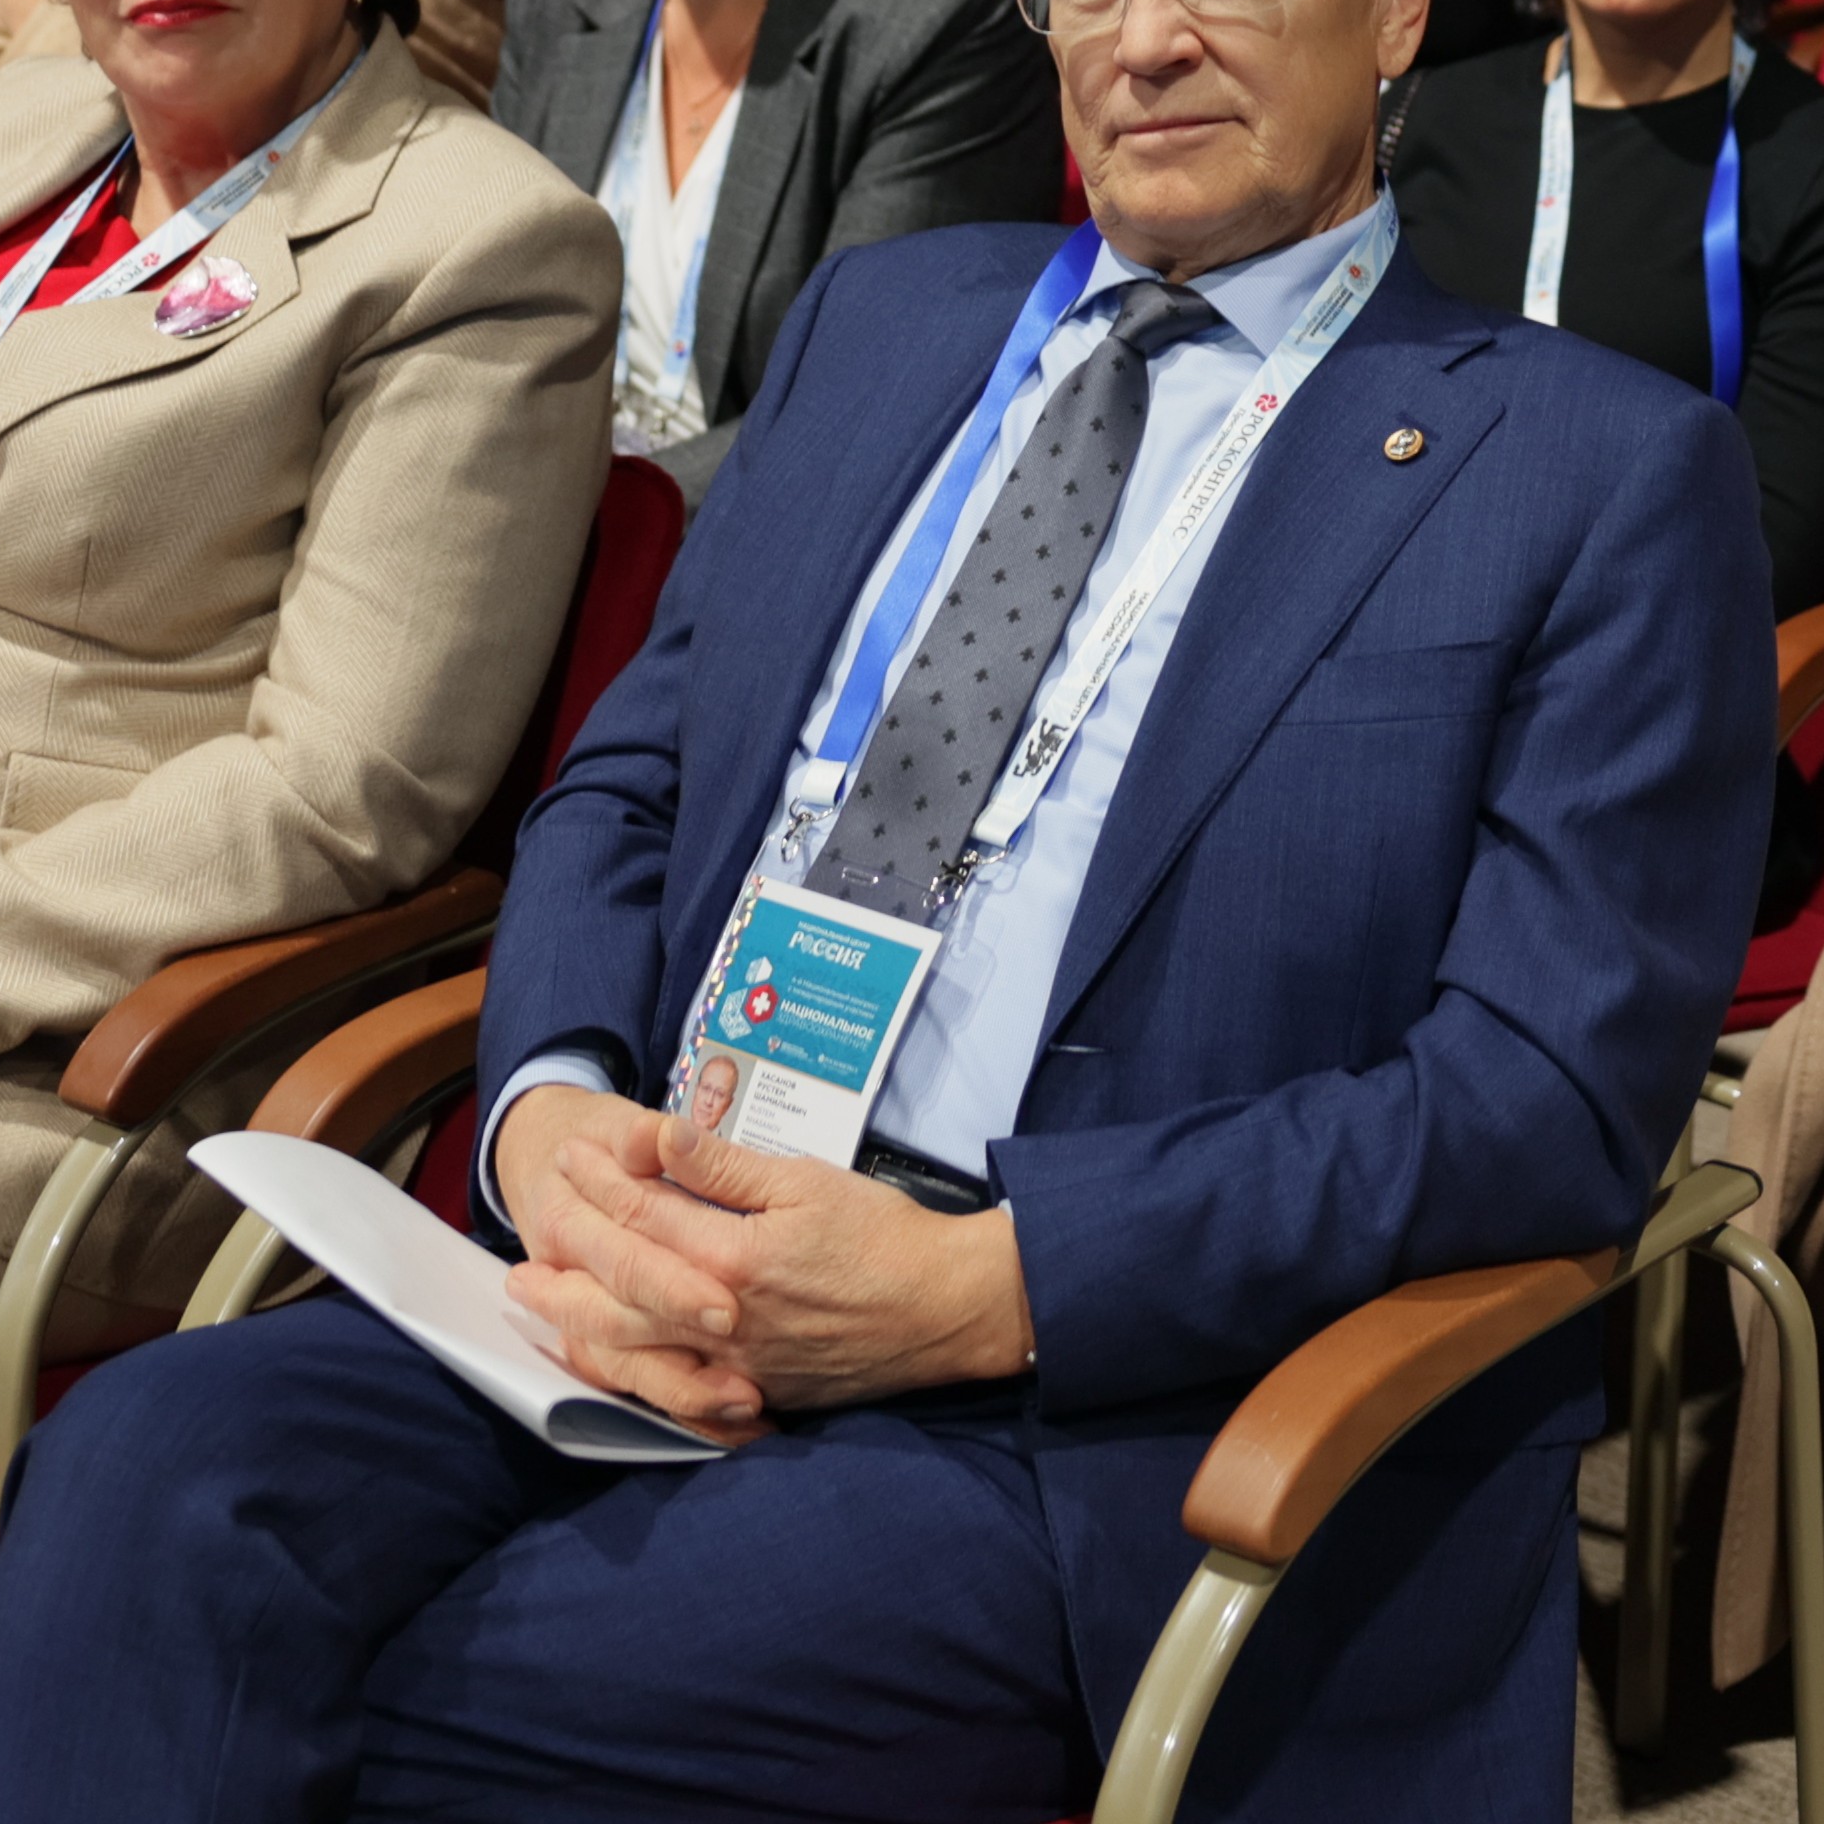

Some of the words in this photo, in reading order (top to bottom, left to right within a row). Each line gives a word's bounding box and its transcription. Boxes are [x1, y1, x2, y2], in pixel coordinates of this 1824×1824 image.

[1170, 410, 1265, 542] РОСКОНГРЕСС
[1089, 590, 1150, 686] НАЦИОНАЛЬНЫЙ
[1067, 684, 1093, 722] ЦЕНТР
[788, 930, 867, 971] РОССИЯ
[778, 998, 876, 1041] НАЦИОНАЛЬНОЕ
[756, 1080, 787, 1097] РУСТЕМ
[760, 1070, 797, 1089] ХАСАНОВ
[752, 1091, 807, 1116] ШАМИЛЬЕВИЧ
